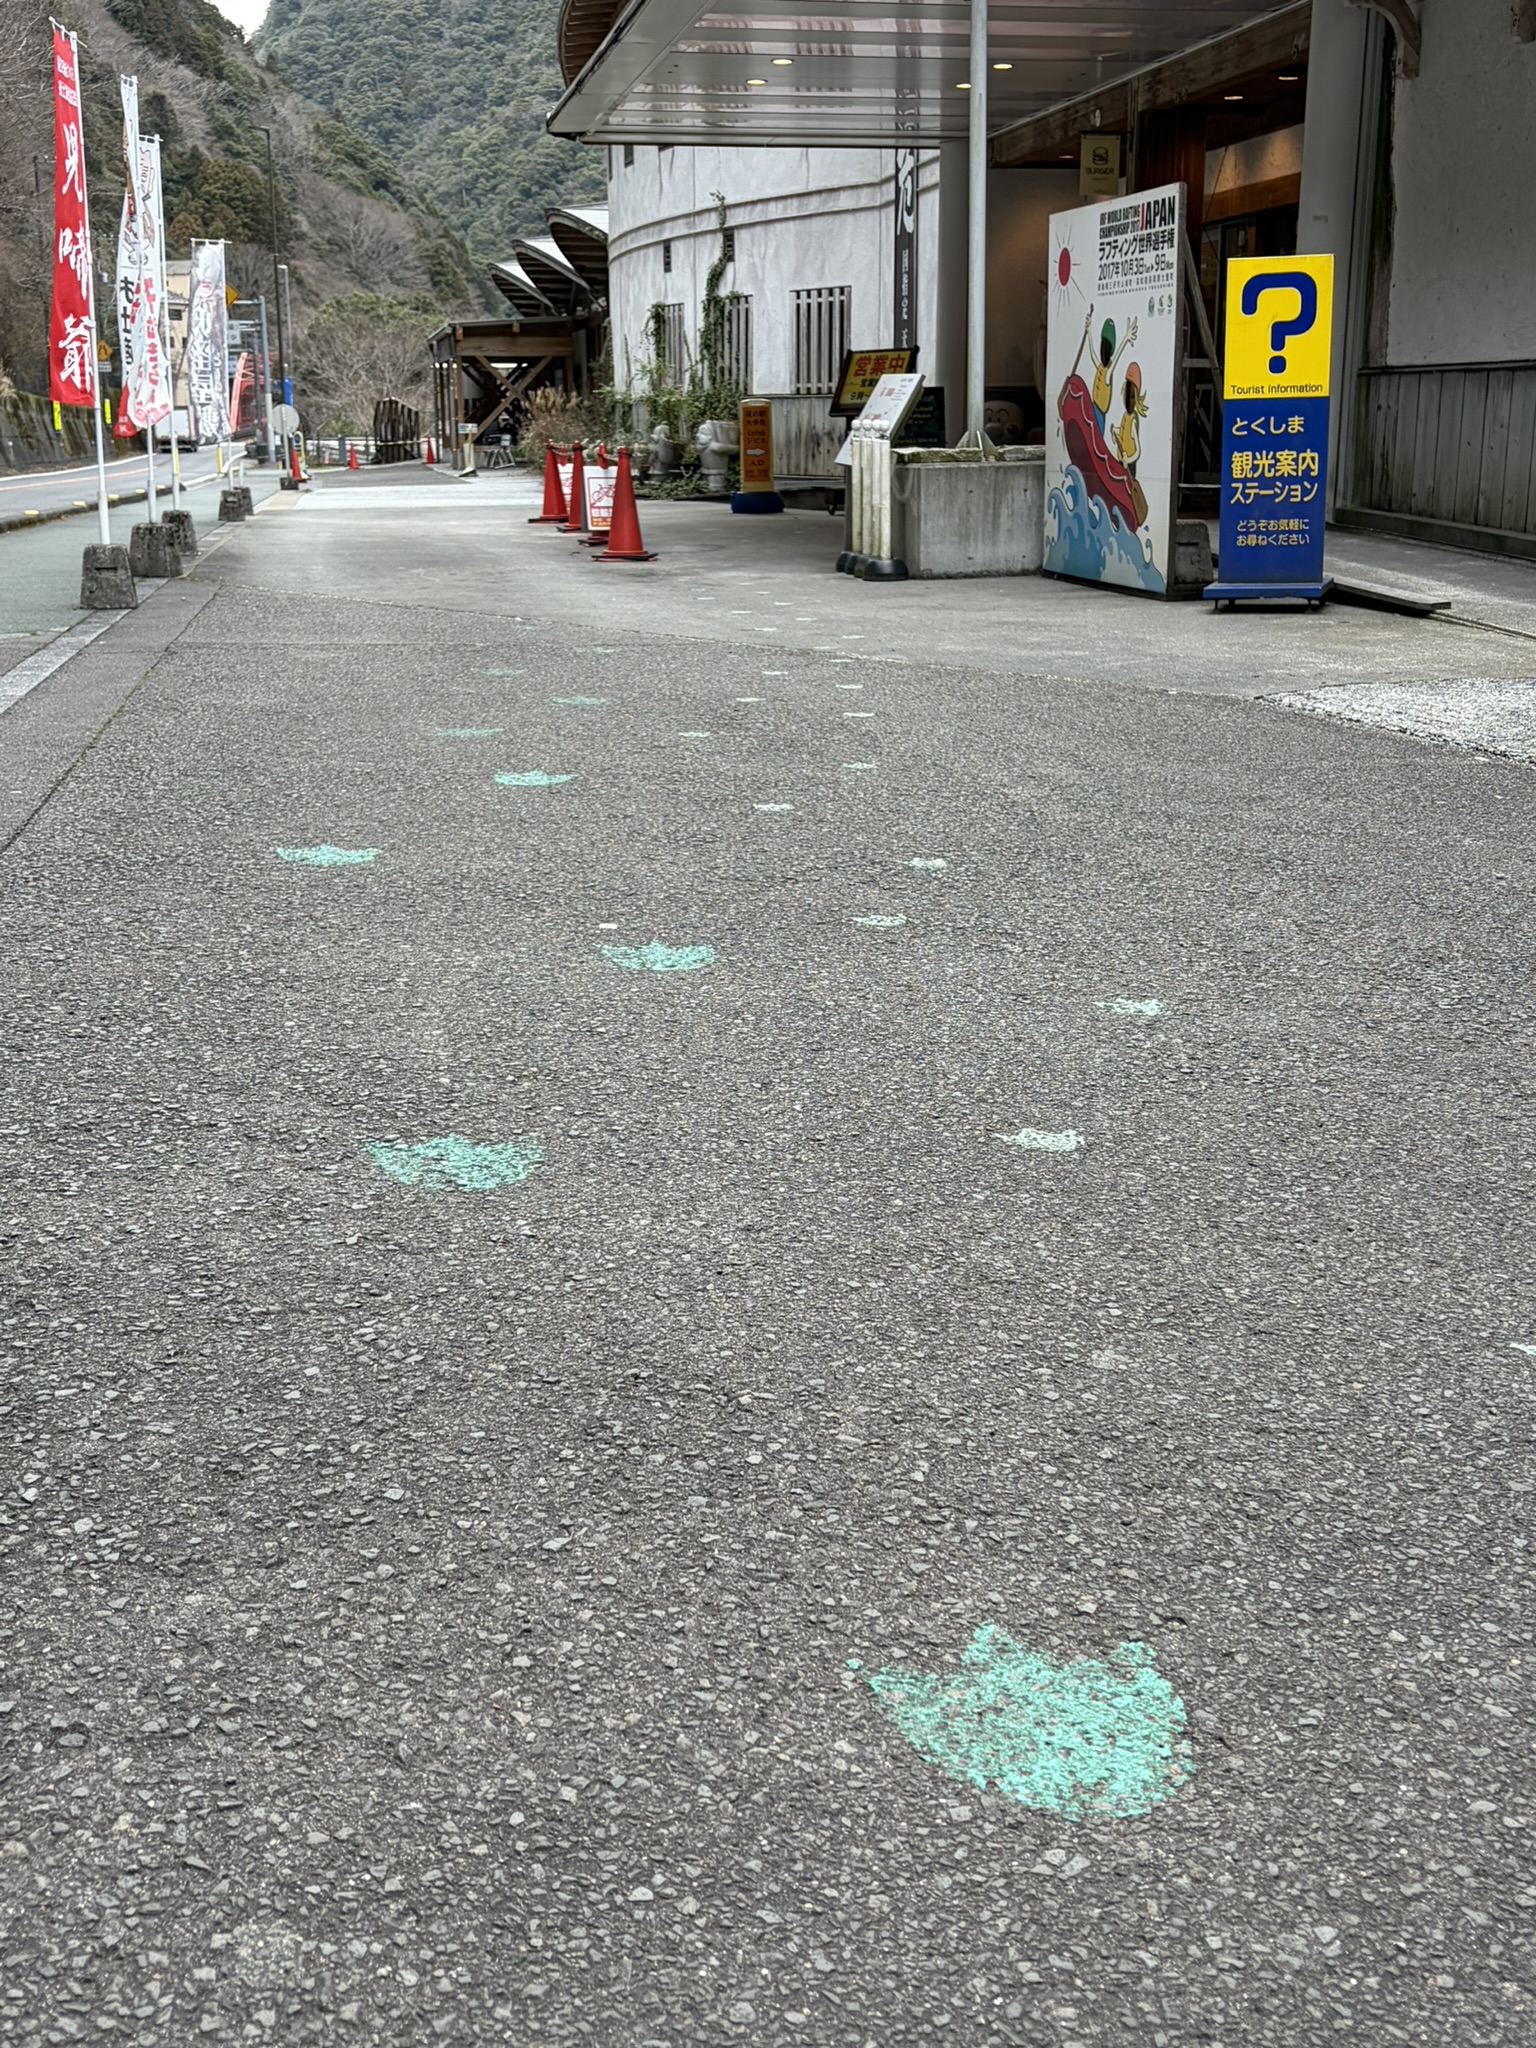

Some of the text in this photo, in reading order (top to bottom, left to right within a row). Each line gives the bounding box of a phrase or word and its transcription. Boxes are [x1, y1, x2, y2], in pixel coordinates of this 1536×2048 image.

[1085, 167, 1115, 175] BURGER
[1140, 195, 1176, 232] JAPAN
[1100, 222, 1130, 240] CHAMPIONSHIP
[1099, 228, 1175, 262] ラフティング世界選手権
[854, 354, 906, 377] 営業中
[1230, 383, 1323, 395] Tourist Information
[1231, 415, 1305, 436] とくしま
[1231, 448, 1319, 479] 観光案内
[1230, 481, 1318, 505] ステーション
[1236, 518, 1310, 532] どうぞお気軽に
[1236, 533, 1310, 547] お尋ねください
